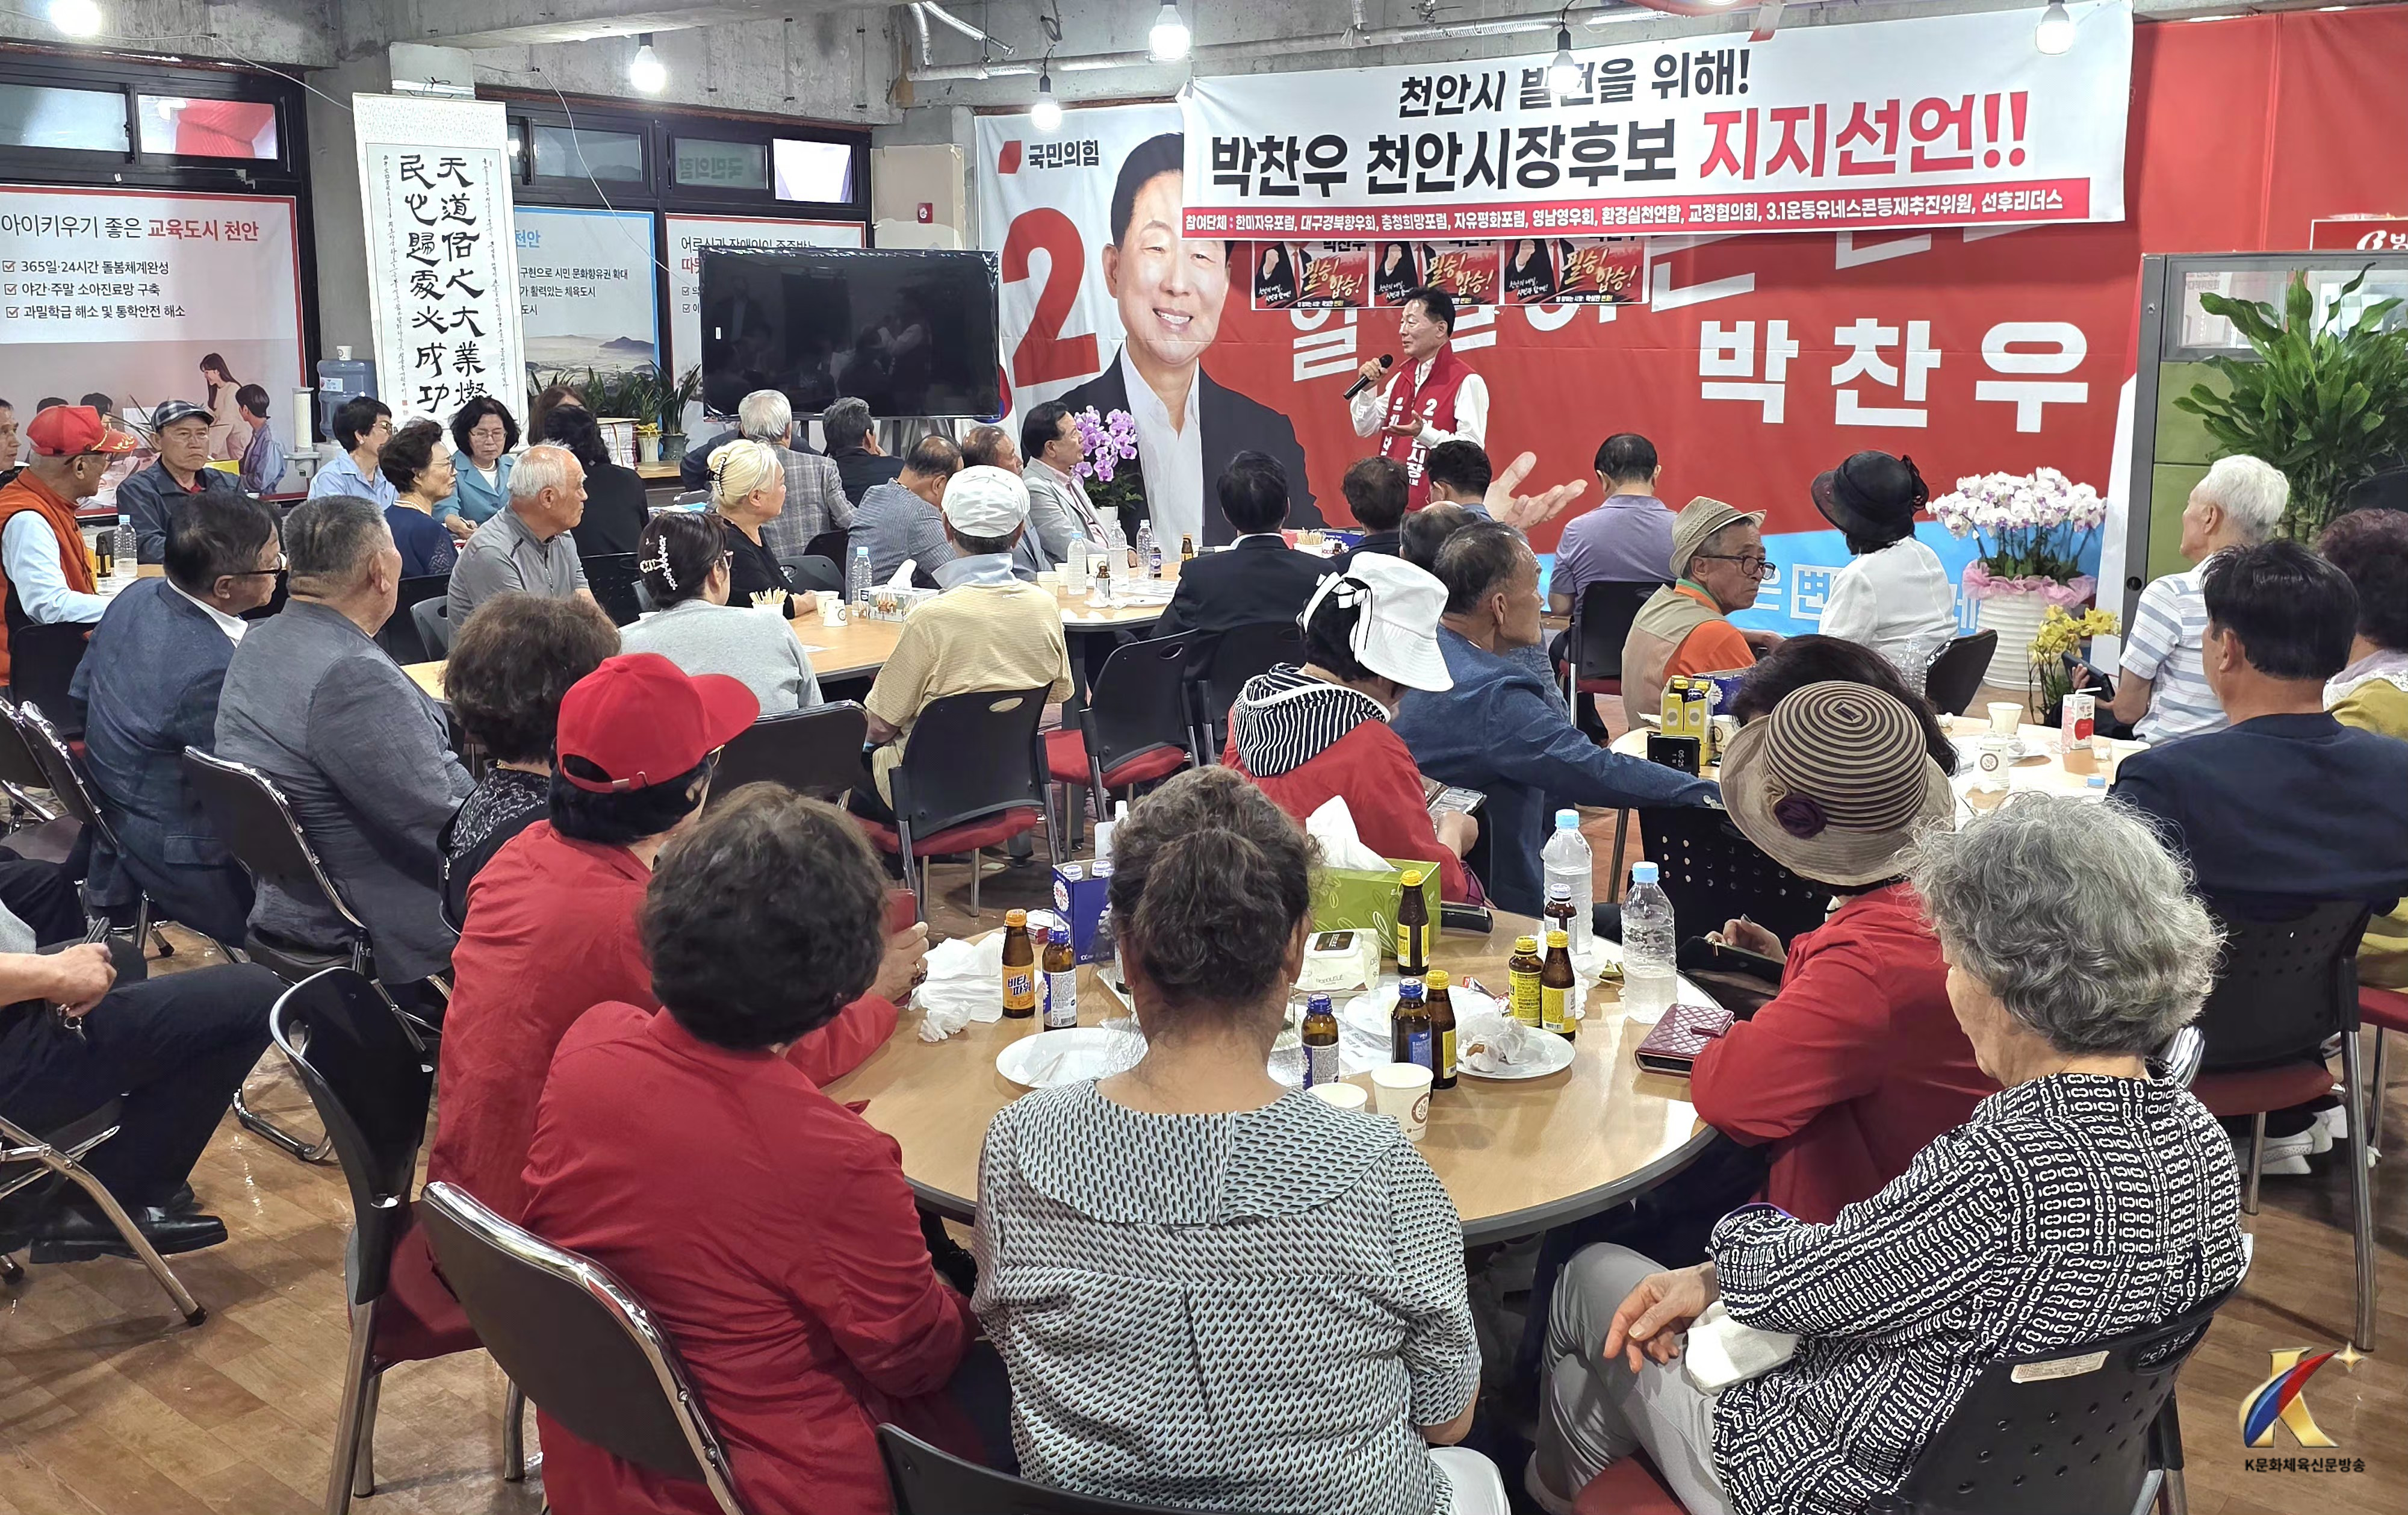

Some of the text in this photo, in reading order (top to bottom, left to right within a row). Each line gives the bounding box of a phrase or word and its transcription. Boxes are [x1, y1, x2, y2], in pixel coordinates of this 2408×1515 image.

[1398, 70, 1507, 119] 천안시
[1651, 49, 1750, 99] 위해!
[1028, 139, 1100, 169] 국민의힘
[1211, 90, 2029, 198] 박찬우 천안시장후보 지지선언!!
[1185, 214, 1227, 231] 참여단체
[1235, 214, 1298, 232] 한미자유포럼,
[1300, 214, 1380, 232] 대구경북향우회,
[1381, 213, 1451, 231] 충청희망포럼,
[1454, 209, 1529, 229] 자유평화포럼,
[1532, 207, 1599, 227] 영남영우회,
[1601, 204, 1685, 225] 환경실천연합,
[1689, 202, 1763, 223] 교정협의회,
[1981, 188, 2064, 213] 선후리더스
[1, 213, 259, 242] 아이키우기 좋은 교육도시 천안
[20, 260, 169, 275] 365일·24시간 돌봄체계완성
[555, 267, 570, 279] 시민
[572, 268, 612, 280] 문화향유권
[613, 269, 628, 280] 확대
[1302, 257, 1340, 291] 필승!
[22, 282, 161, 297] 야간·주말 소아진료망 구축
[530, 285, 563, 297] 활력있는
[565, 286, 596, 297] 체육도시
[1002, 207, 1101, 388] 2
[1329, 273, 1364, 299] 압승!
[23, 305, 186, 320] 과밀학급 해소 및 통학안전 해소
[522, 304, 538, 316] 도시
[1698, 317, 2089, 432] 박찬우
[1423, 398, 1438, 416] 2
[1007, 974, 1027, 989] 비타
